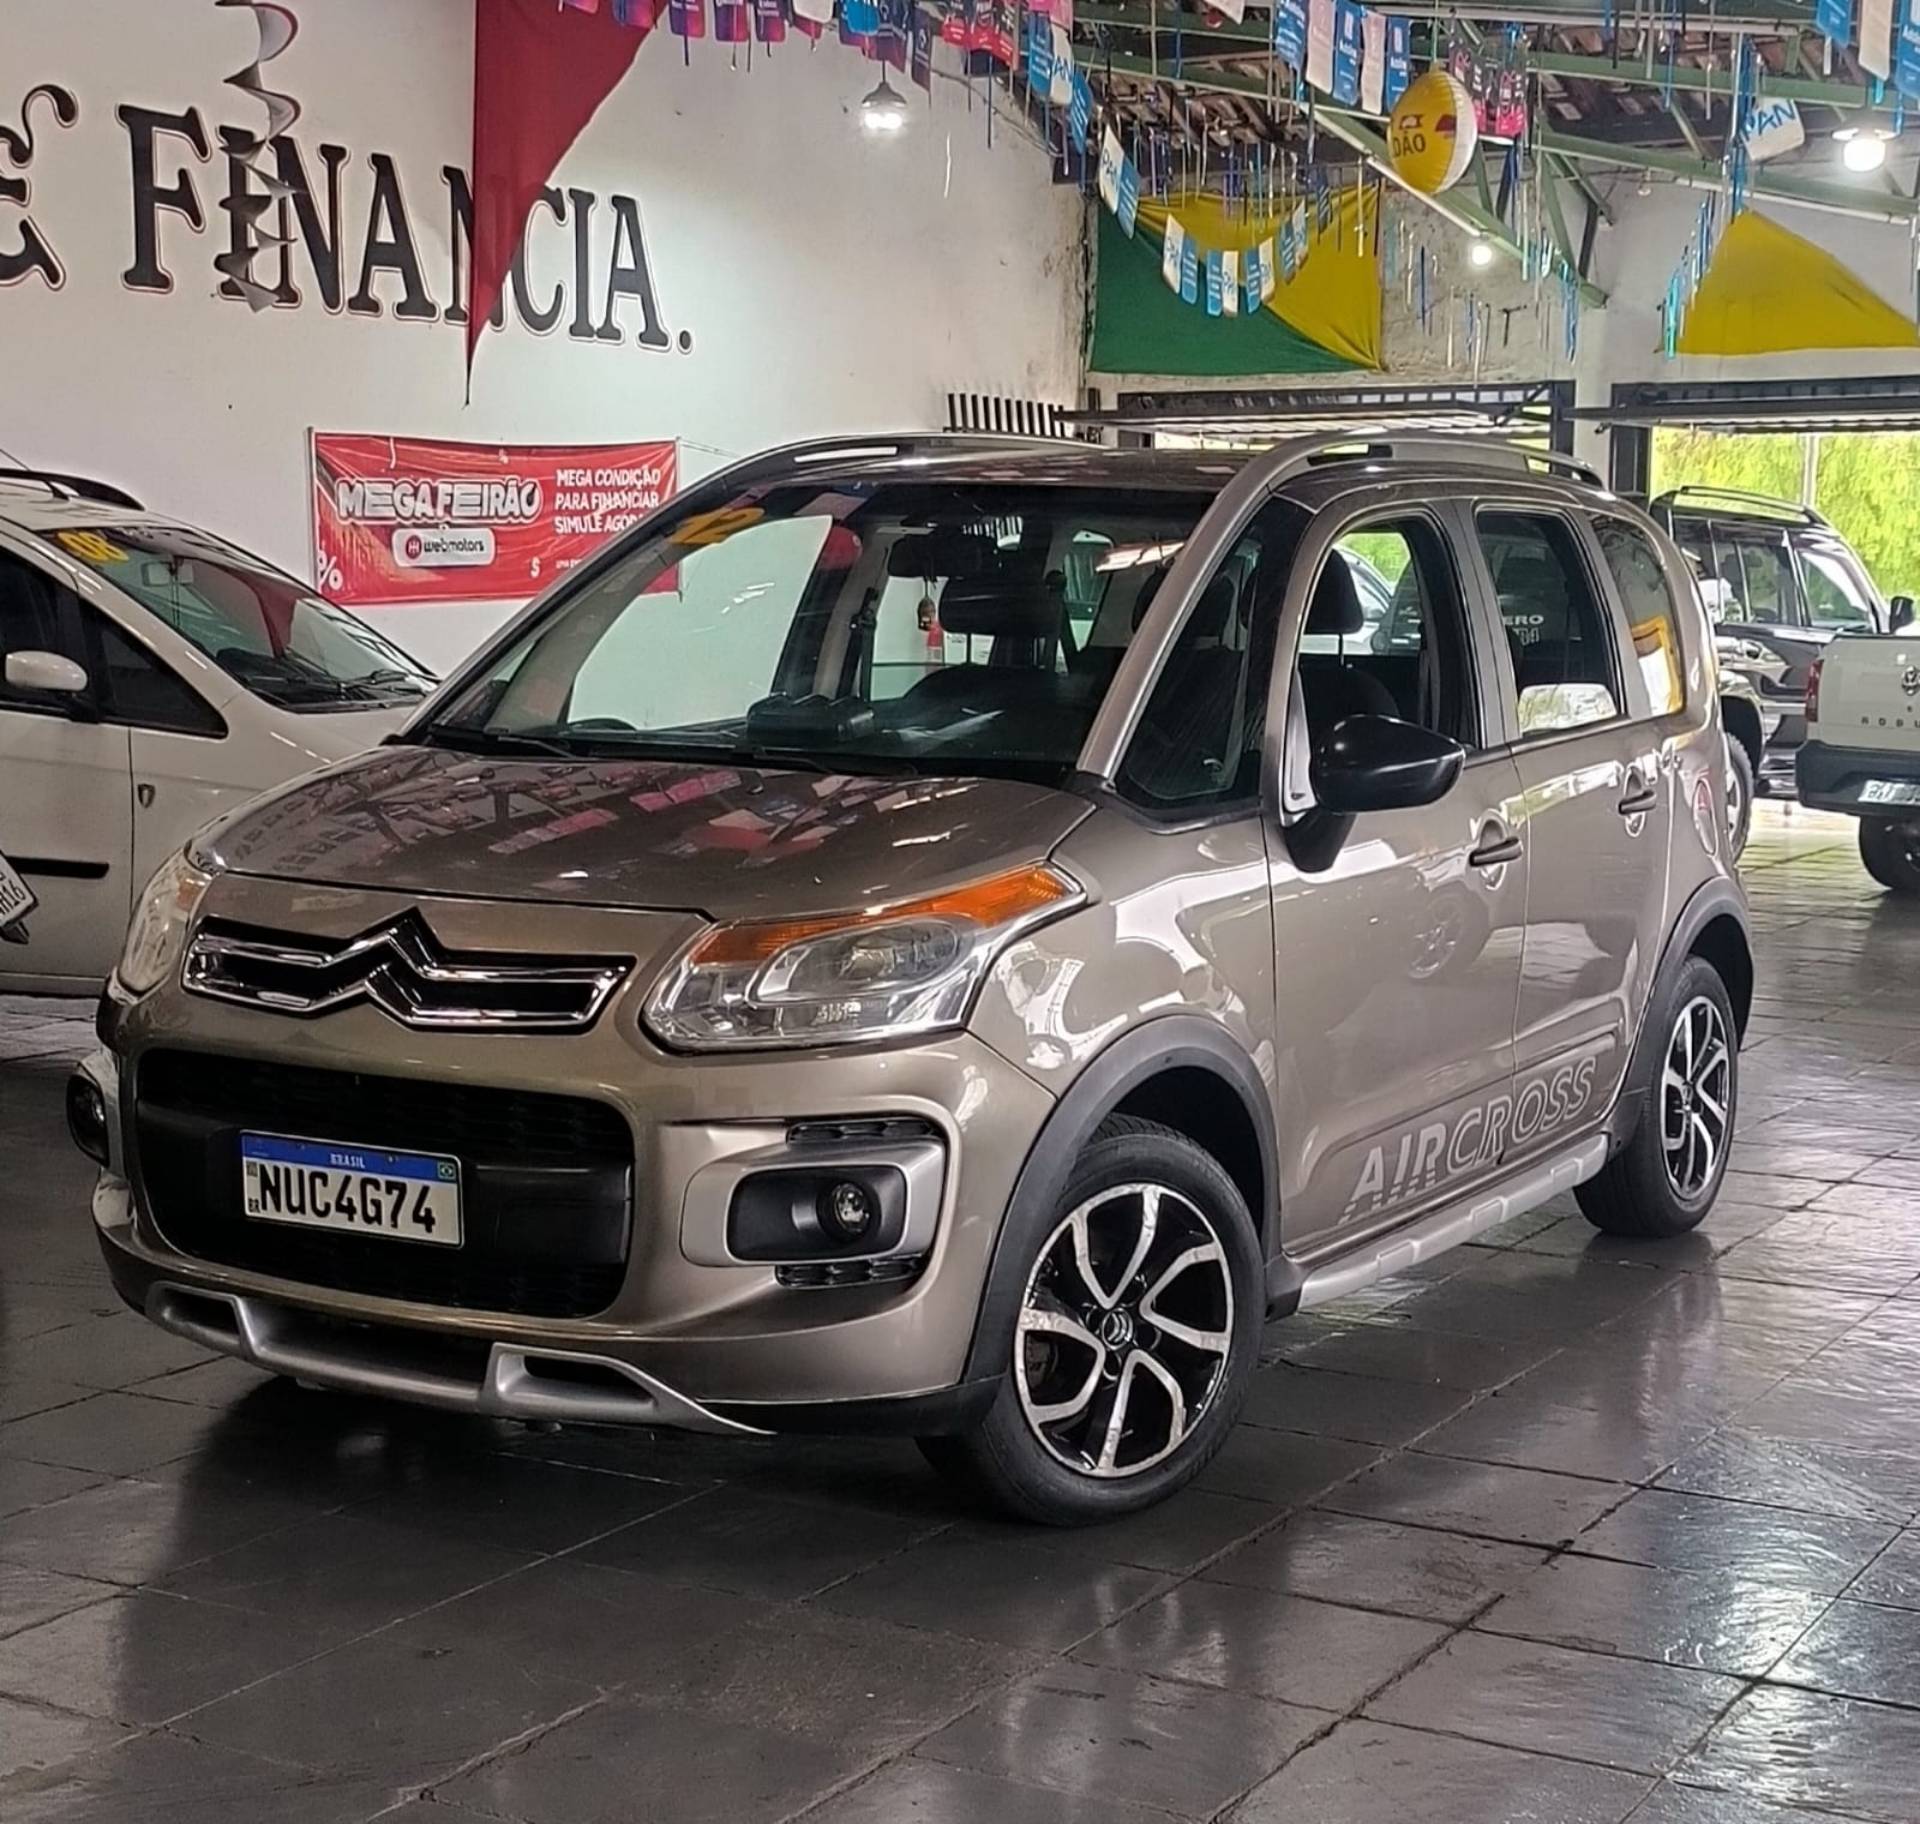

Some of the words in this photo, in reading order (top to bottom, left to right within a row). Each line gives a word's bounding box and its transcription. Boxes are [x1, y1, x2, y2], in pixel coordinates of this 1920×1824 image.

[556, 468, 593, 487] MEGA
[595, 464, 662, 489] CONDIÇÃO
[555, 492, 590, 510] PARA
[591, 488, 660, 510] FINANCIAR
[554, 512, 603, 533] SIMULE
[423, 537, 484, 552] webmotors
[1337, 1056, 1597, 1225] AIRCROSS
[330, 1153, 366, 1170] BRASIL
[259, 1163, 436, 1234] NUC4G74
